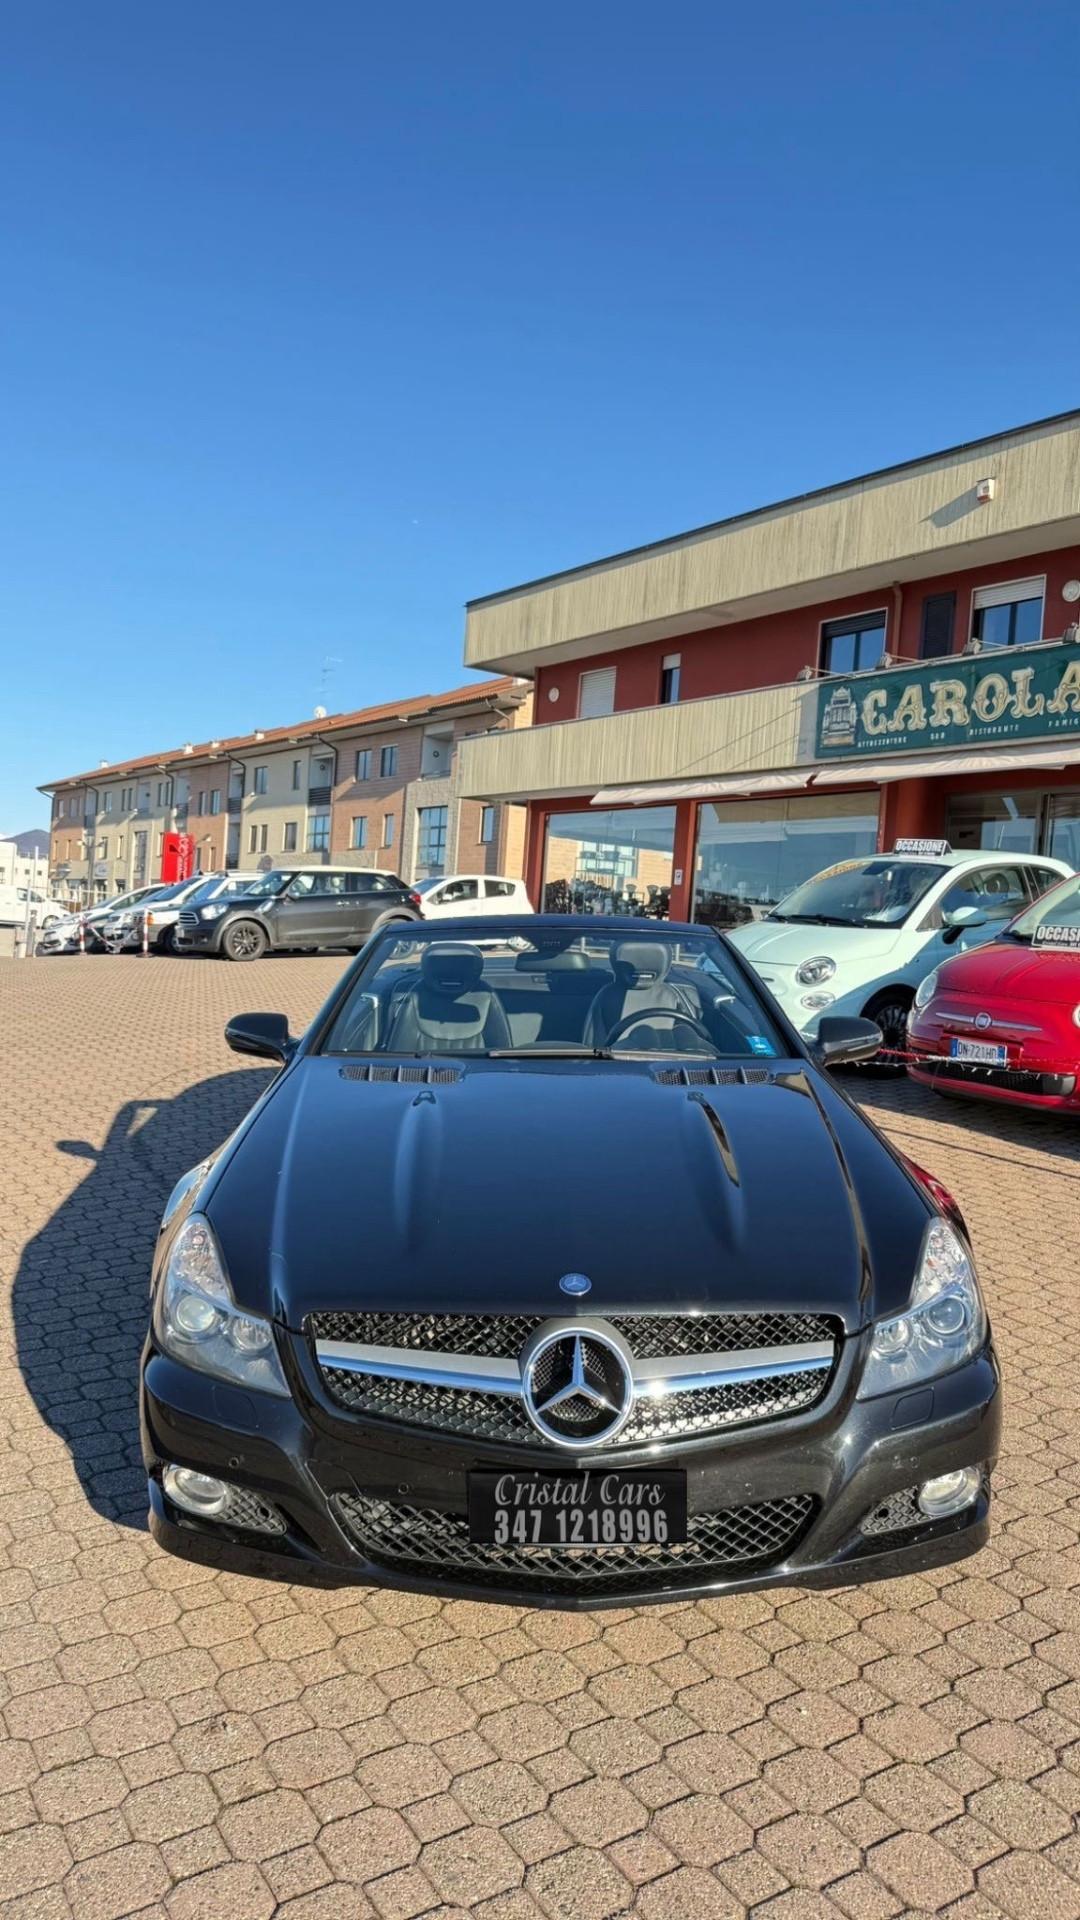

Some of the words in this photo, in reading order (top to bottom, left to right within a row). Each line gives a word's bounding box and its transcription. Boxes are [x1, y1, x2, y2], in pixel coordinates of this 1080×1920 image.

[861, 660, 1080, 736] CAROLA
[969, 724, 1019, 736] RISTORANTE
[896, 840, 943, 851] OCCASIONE
[494, 1470, 592, 1506] Cristal
[600, 1474, 666, 1506] Cars
[494, 1509, 542, 1545] 347
[555, 1508, 669, 1544] 1218996
